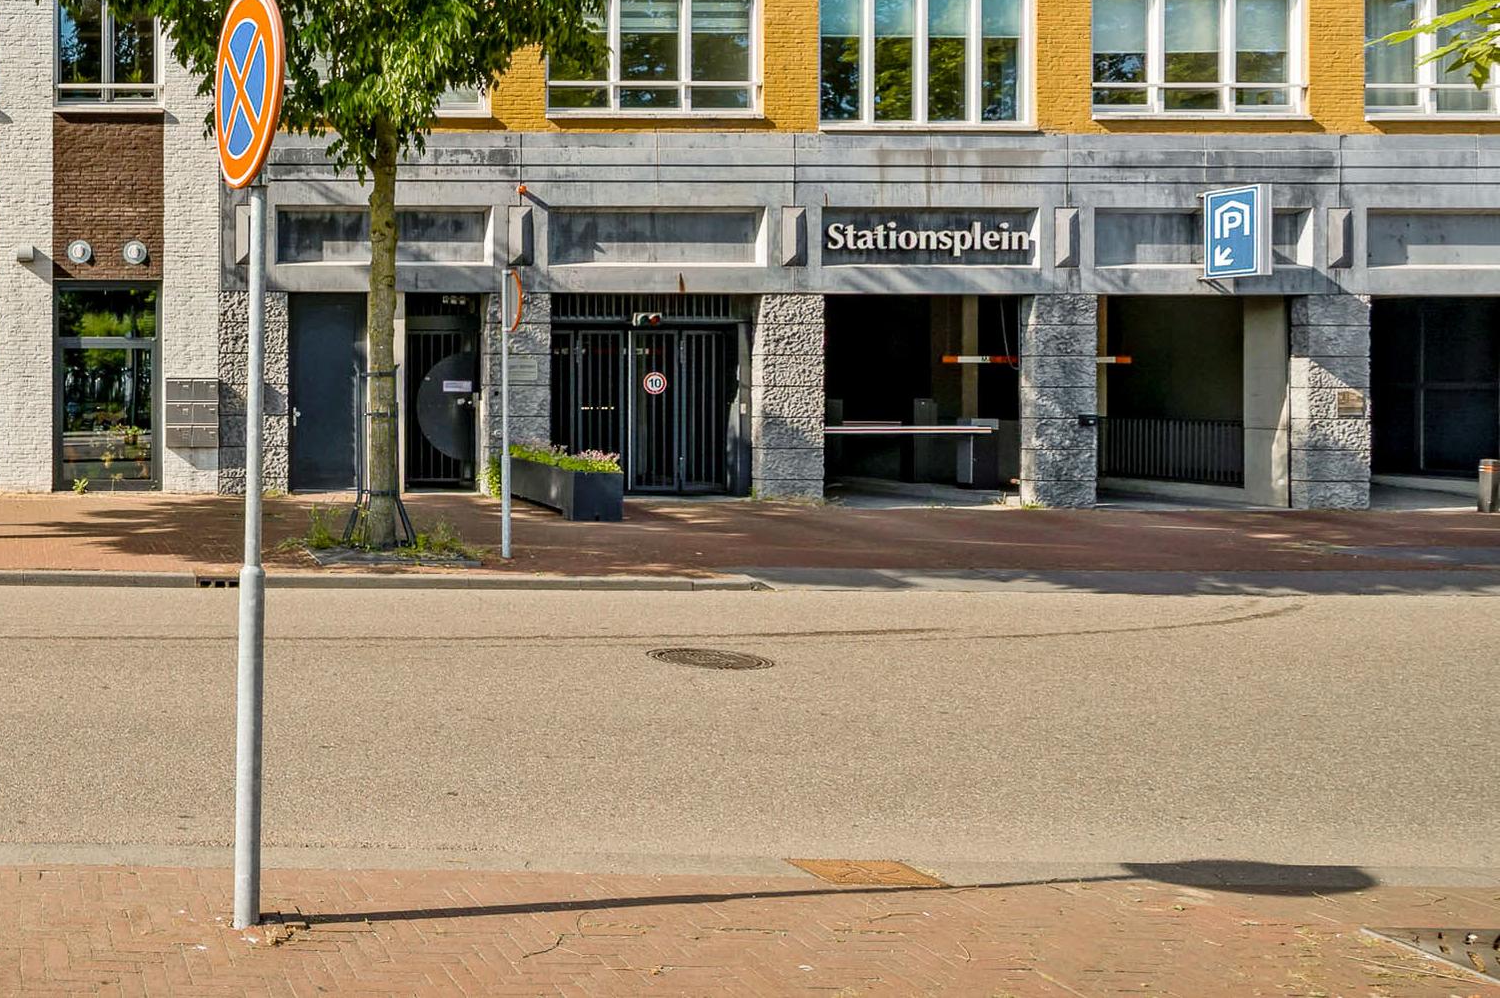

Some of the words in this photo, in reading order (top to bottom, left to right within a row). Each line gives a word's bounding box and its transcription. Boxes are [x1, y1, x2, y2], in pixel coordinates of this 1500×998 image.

[1223, 210, 1242, 239] P
[827, 222, 1030, 257] Stationsplein
[649, 378, 662, 389] 10
